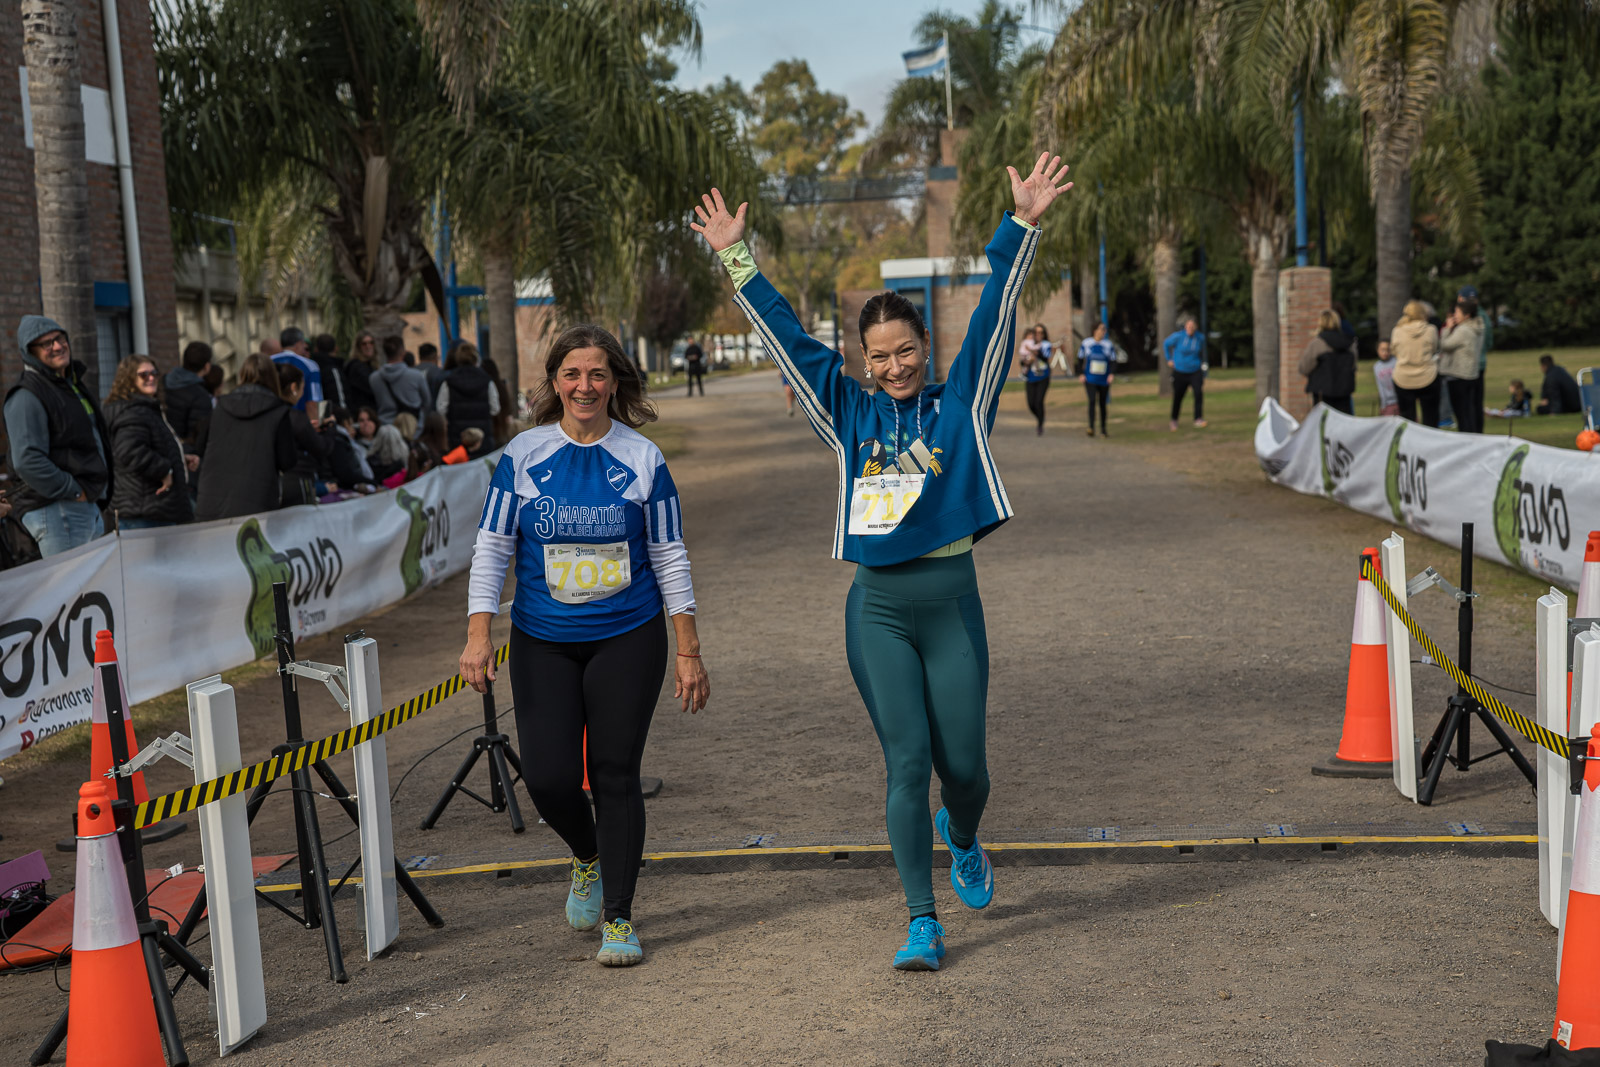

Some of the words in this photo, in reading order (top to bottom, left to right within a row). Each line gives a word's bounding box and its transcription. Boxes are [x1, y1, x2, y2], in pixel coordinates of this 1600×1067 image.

[534, 495, 556, 539] 3
[557, 504, 626, 524] MARATÓN
[575, 546, 581, 557] 3
[552, 559, 622, 591] 708
